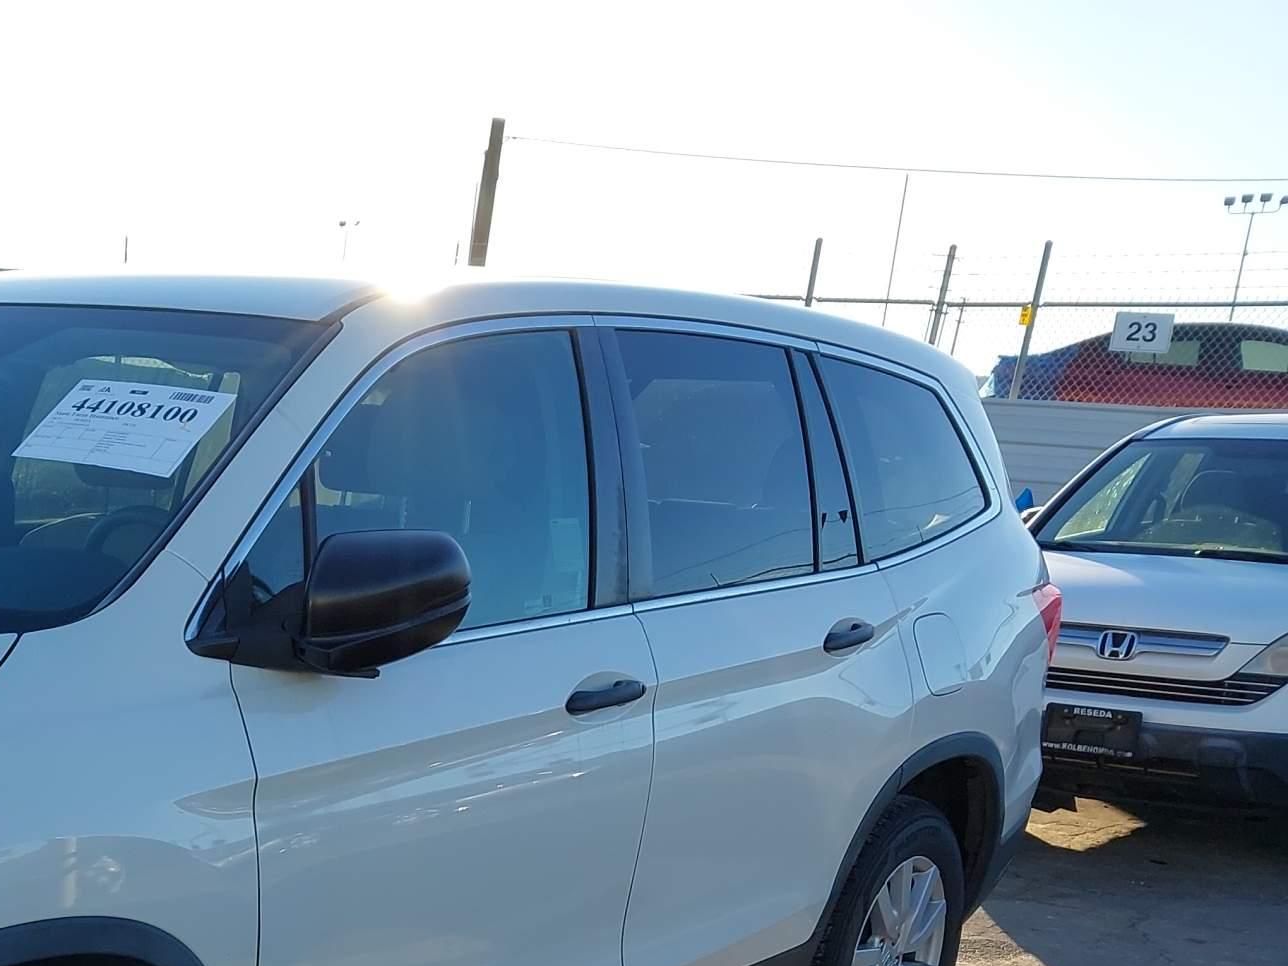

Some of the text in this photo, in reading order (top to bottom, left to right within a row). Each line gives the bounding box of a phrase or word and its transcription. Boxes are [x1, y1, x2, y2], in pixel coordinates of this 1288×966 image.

[1125, 321, 1158, 344] 23
[71, 398, 199, 424] 44108100
[1073, 707, 1113, 719] RESEDA
